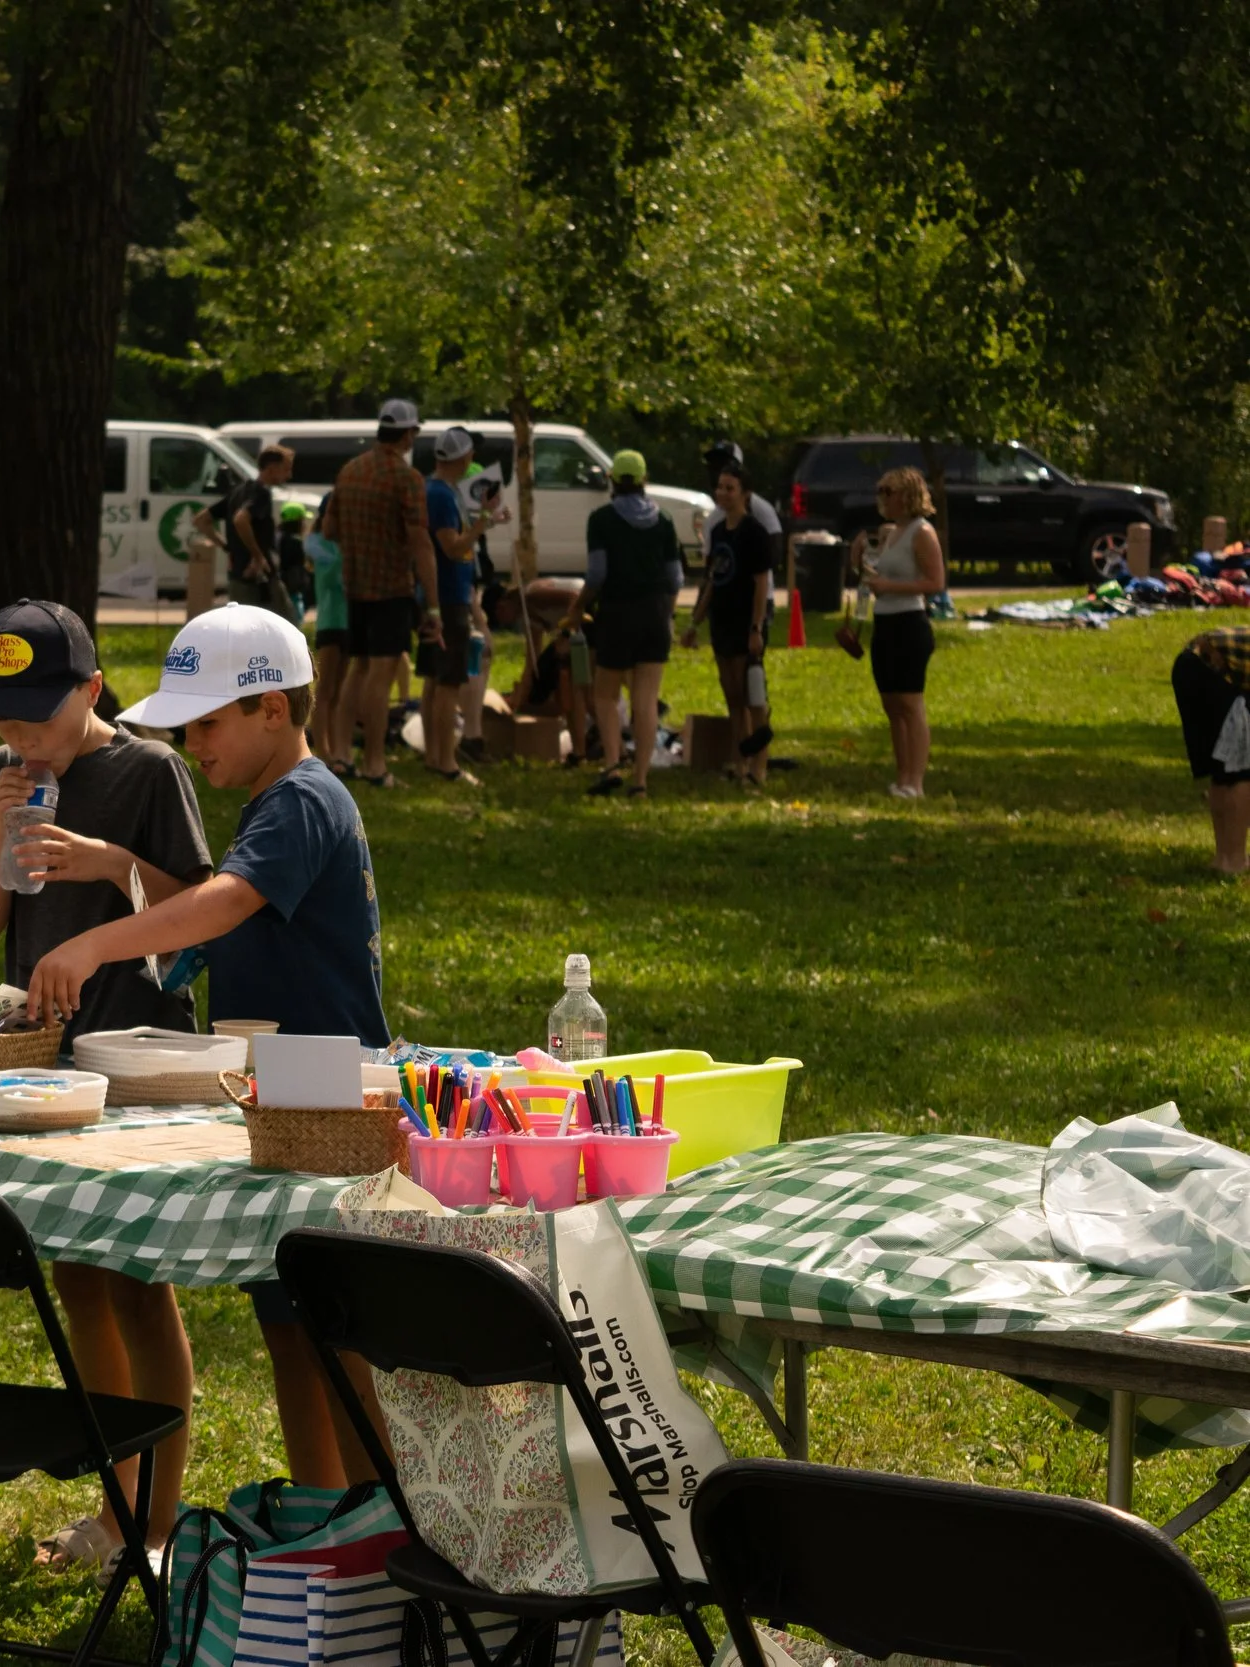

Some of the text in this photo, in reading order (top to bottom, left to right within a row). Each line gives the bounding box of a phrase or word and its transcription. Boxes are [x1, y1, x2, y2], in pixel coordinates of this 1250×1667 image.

[100, 504, 131, 524] ss
[249, 655, 268, 666] CHS
[237, 668, 283, 687] CHS FIELD
[605, 1316, 700, 1511] Shop Marshalls.com
